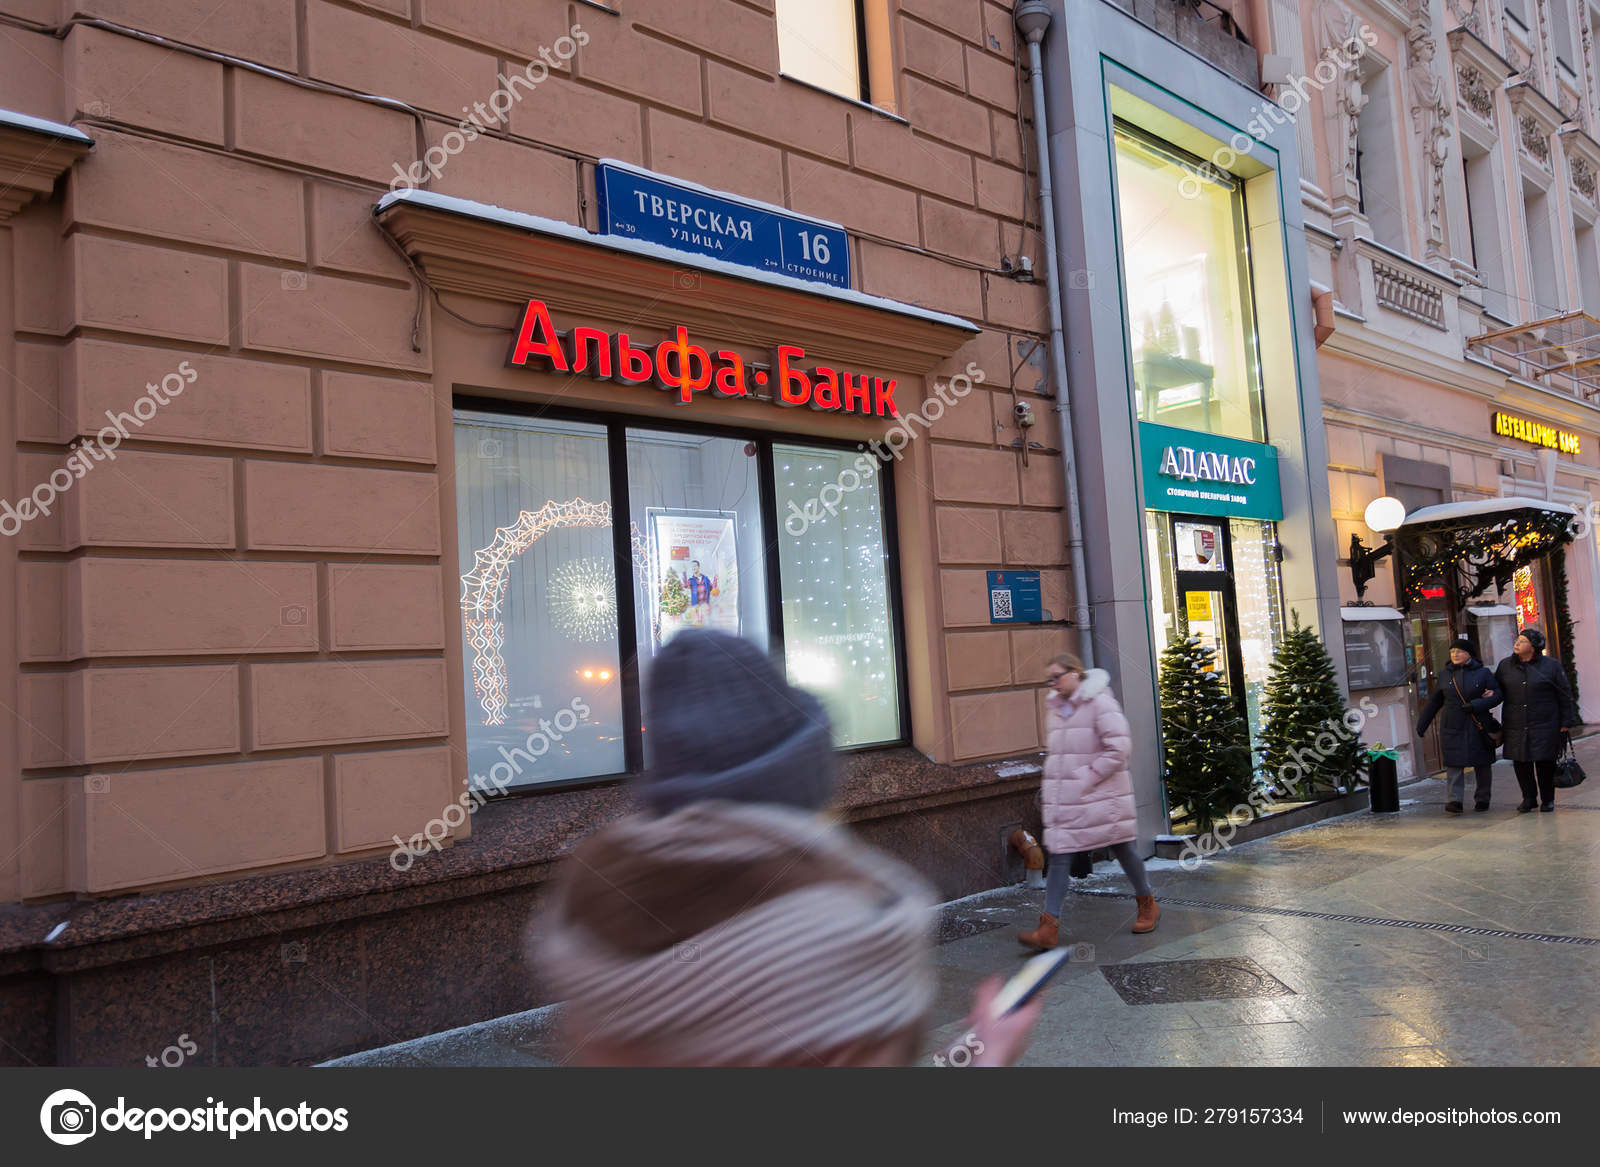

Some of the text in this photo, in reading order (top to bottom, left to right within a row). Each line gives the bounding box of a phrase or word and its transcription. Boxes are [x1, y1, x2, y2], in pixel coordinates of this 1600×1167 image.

[625, 223, 636, 233] 30
[633, 190, 753, 242] ТВЕРСКАЯ
[670, 227, 724, 250] УЛИЦА
[798, 231, 831, 265] 16
[764, 258, 770, 266] 2
[787, 263, 839, 282] СТРОЕНИЕ
[1496, 412, 1580, 454] ЛЕГЕНДАРНОЕ КАФЕ
[1164, 445, 1256, 485] АДАМАС
